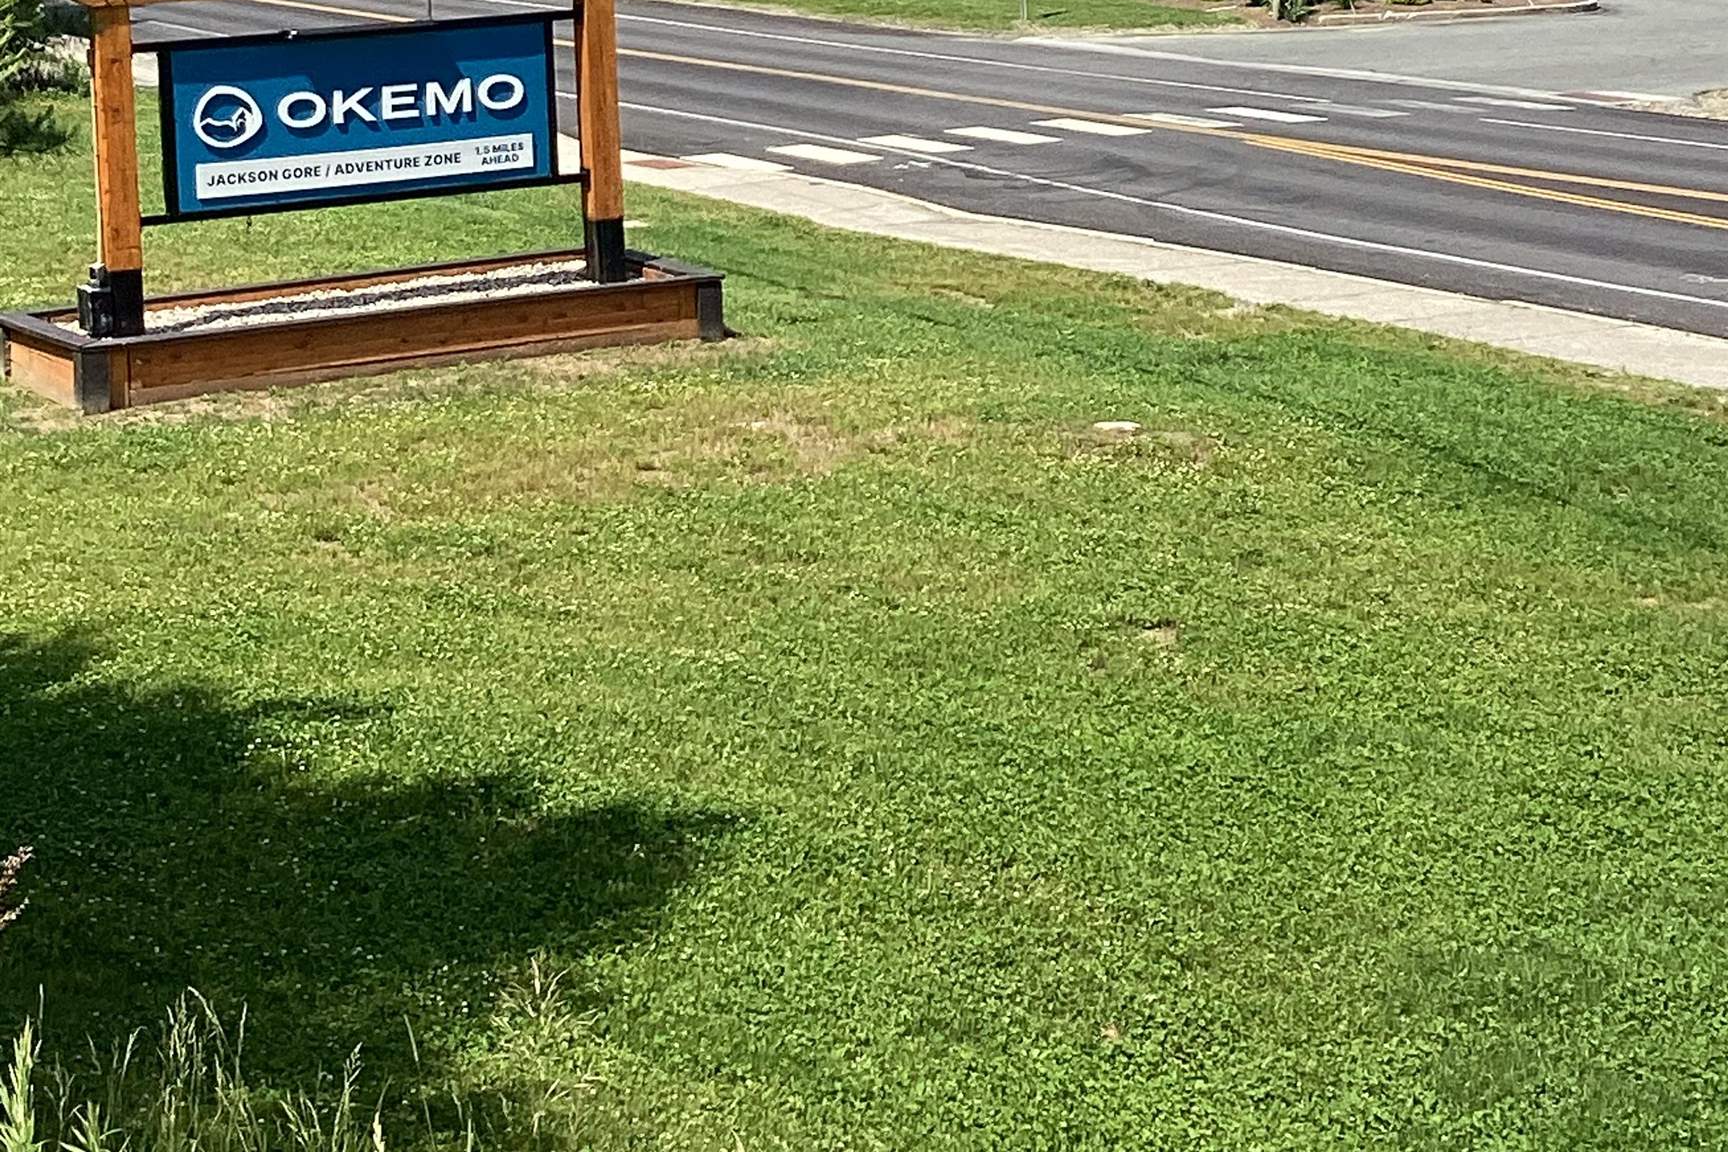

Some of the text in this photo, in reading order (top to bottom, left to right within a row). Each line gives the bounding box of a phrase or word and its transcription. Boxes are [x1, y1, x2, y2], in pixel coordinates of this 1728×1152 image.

[277, 73, 525, 129] OKEMO
[481, 153, 520, 166] AHEAD
[492, 142, 525, 153] MILES
[207, 169, 279, 187] JACKSON
[282, 165, 322, 180] GORE
[334, 156, 420, 175] ADVENTURE
[424, 152, 462, 167] ZONE
